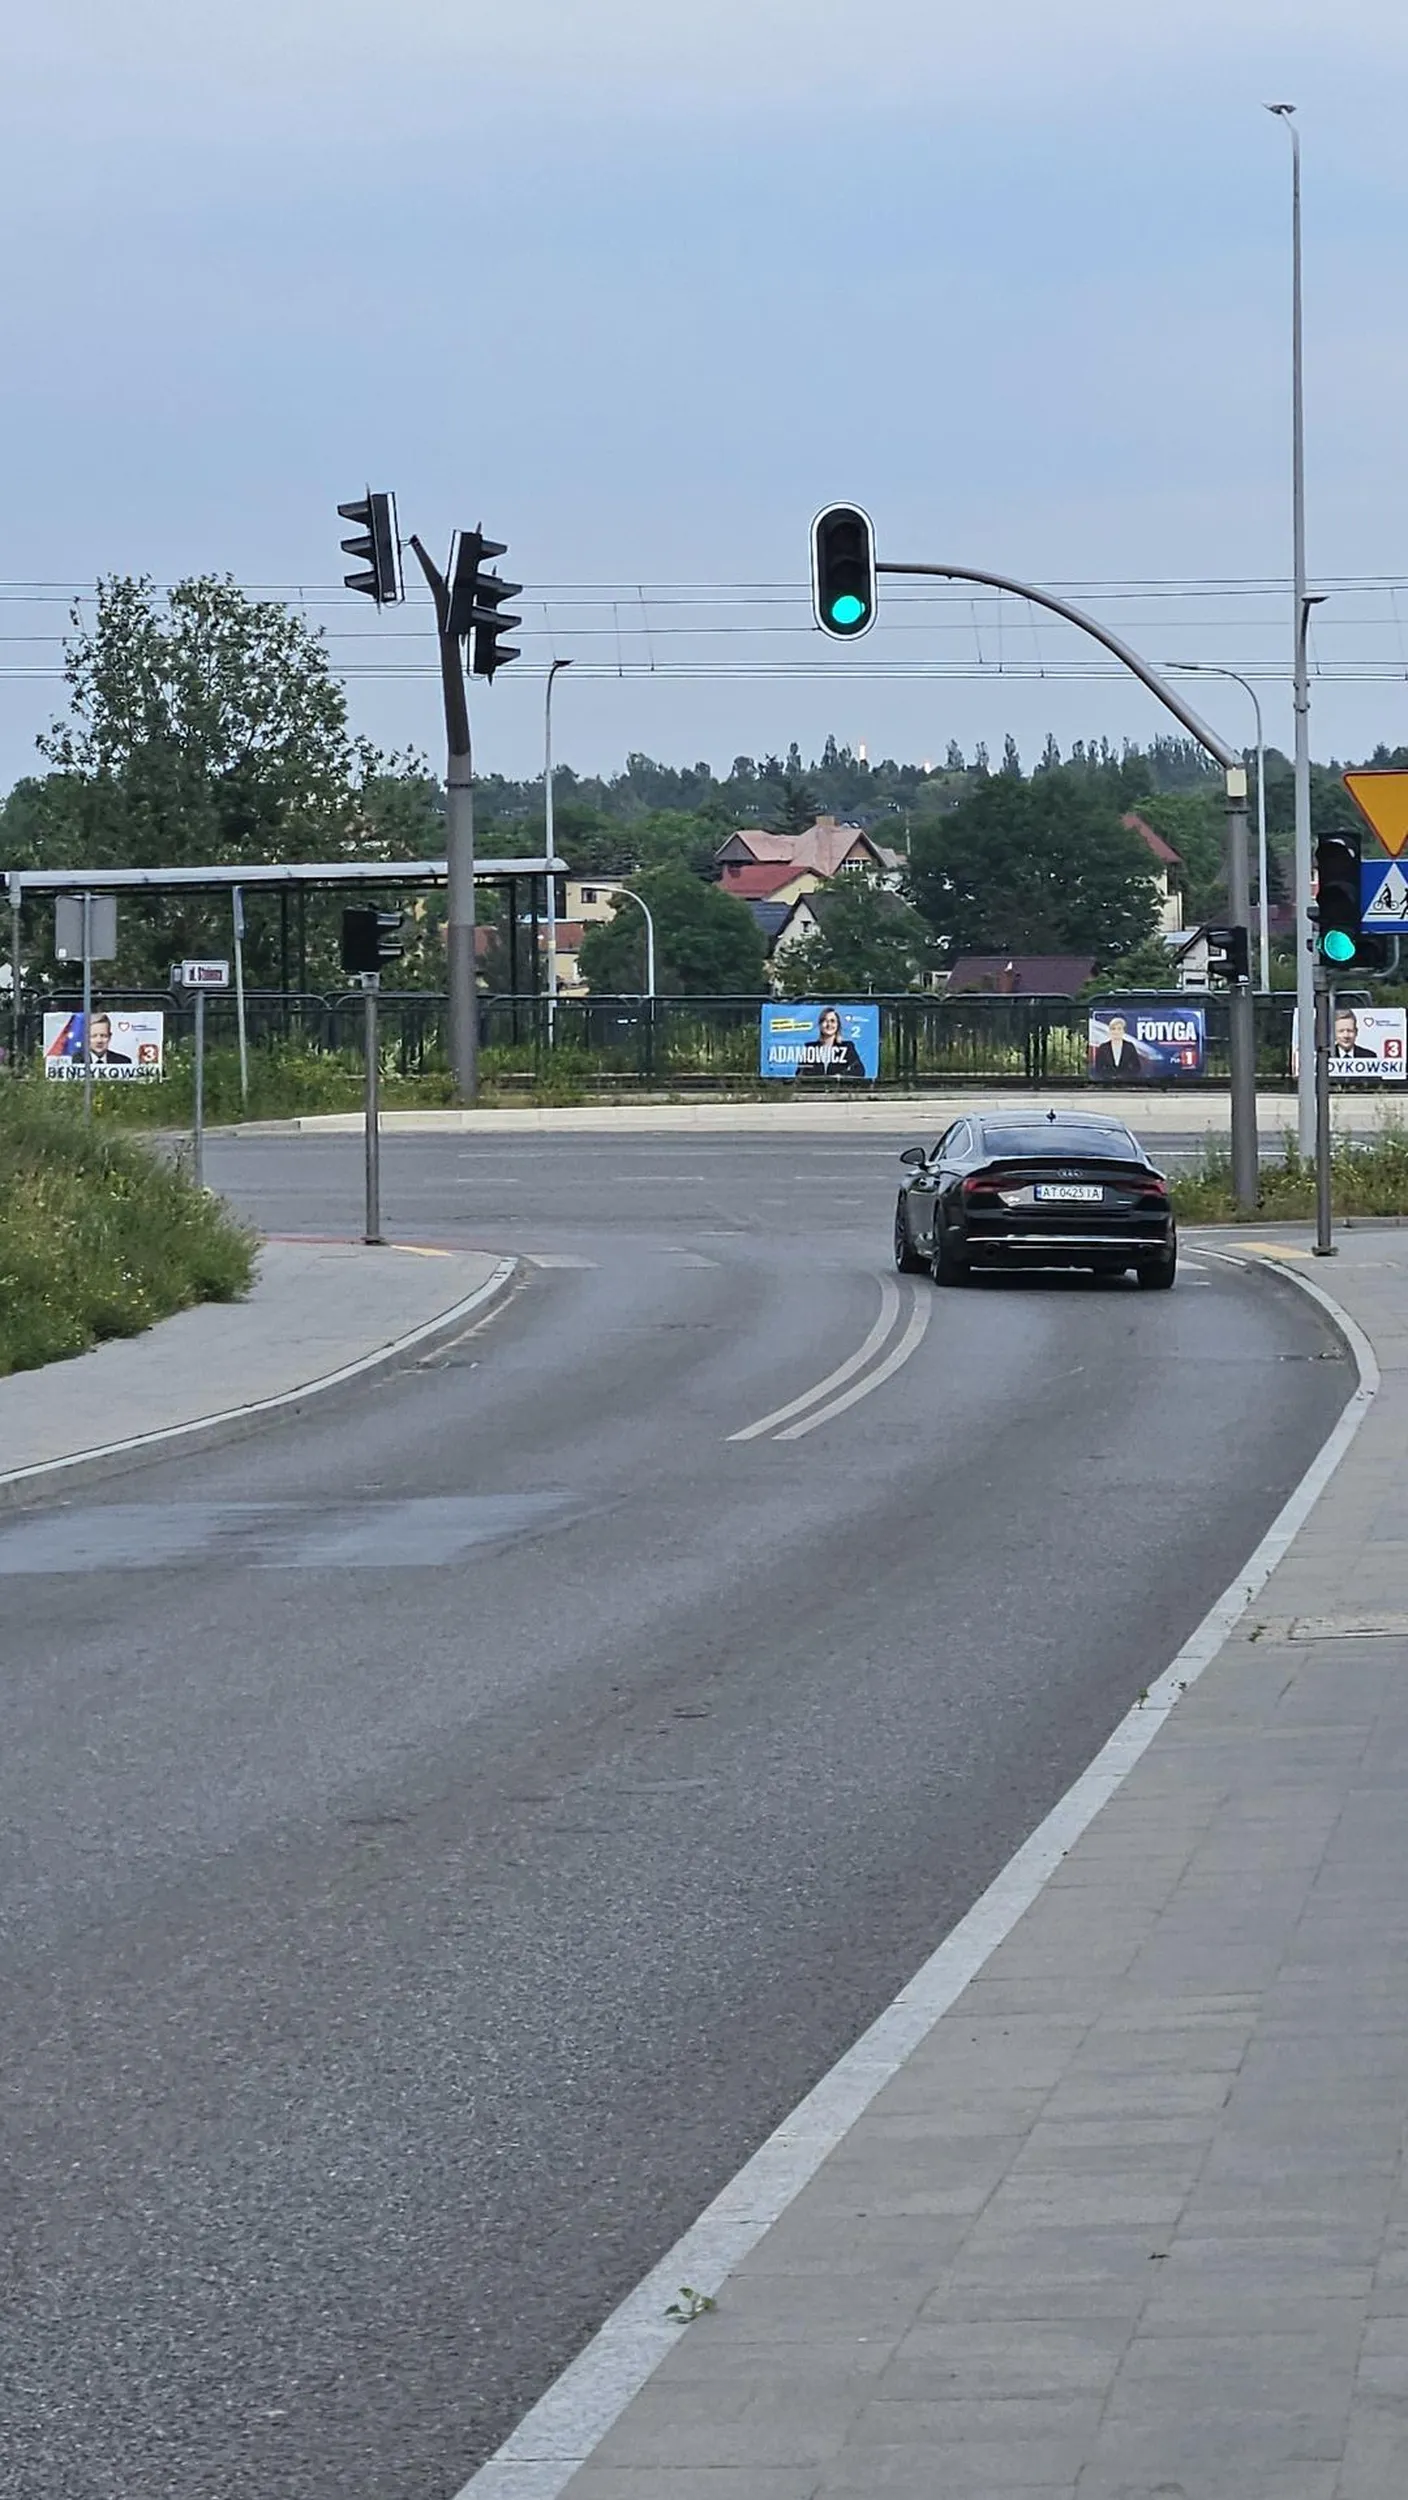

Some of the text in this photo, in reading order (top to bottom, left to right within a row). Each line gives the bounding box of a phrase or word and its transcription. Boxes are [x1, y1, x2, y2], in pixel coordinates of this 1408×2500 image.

[851, 1026, 861, 1038] 2
[1137, 1022, 1197, 1041] FOTYGA
[142, 1048, 154, 1060] 3
[769, 1046, 847, 1063] ADAMOWICZ
[1388, 1041, 1400, 1056] 3
[1185, 1051, 1192, 1065] 1
[1328, 1061, 1403, 1073] DYKOWSKI
[1043, 1187, 1057, 1197] AT
